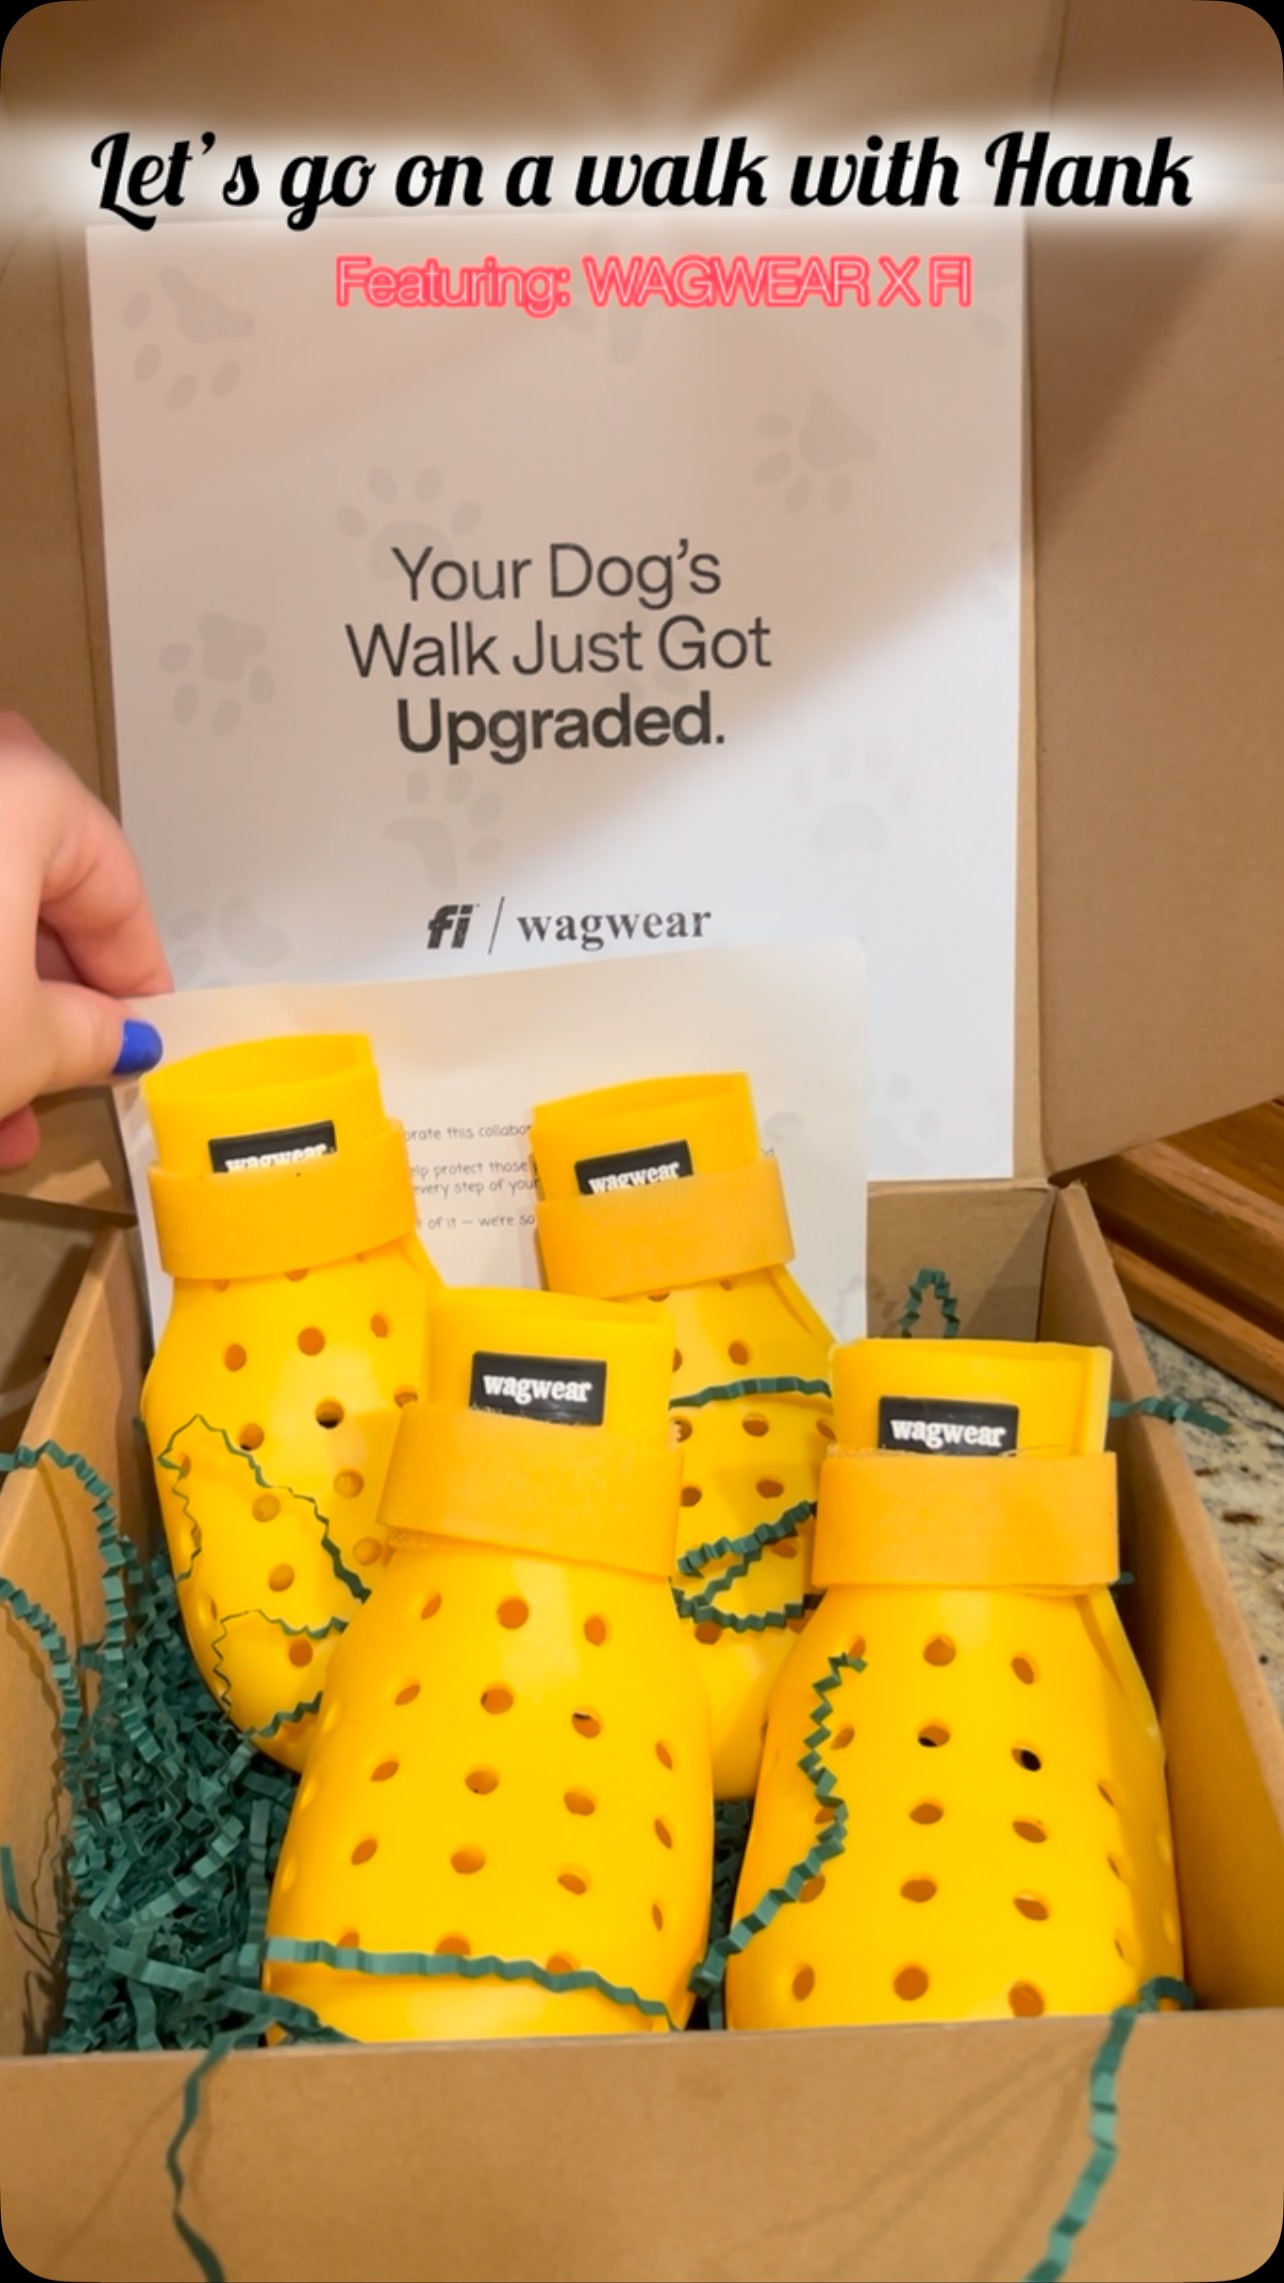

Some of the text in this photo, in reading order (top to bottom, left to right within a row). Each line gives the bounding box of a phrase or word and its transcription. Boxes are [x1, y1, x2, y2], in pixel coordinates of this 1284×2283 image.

[391, 539, 721, 610] Your Dog’s
[345, 615, 772, 678] Walk Just Got
[397, 690, 725, 765] Upgraded.
[427, 903, 474, 949] fi
[517, 911, 711, 951] wagwear
[447, 1126, 474, 1140] this
[433, 1161, 483, 1180] protect
[489, 1160, 528, 1174] those
[455, 1181, 484, 1198] step
[489, 1178, 504, 1192] of
[428, 1216, 444, 1230] of
[519, 1214, 536, 1227] so
[482, 1374, 592, 1406] wagwear
[889, 1419, 1006, 1450] wagwear
